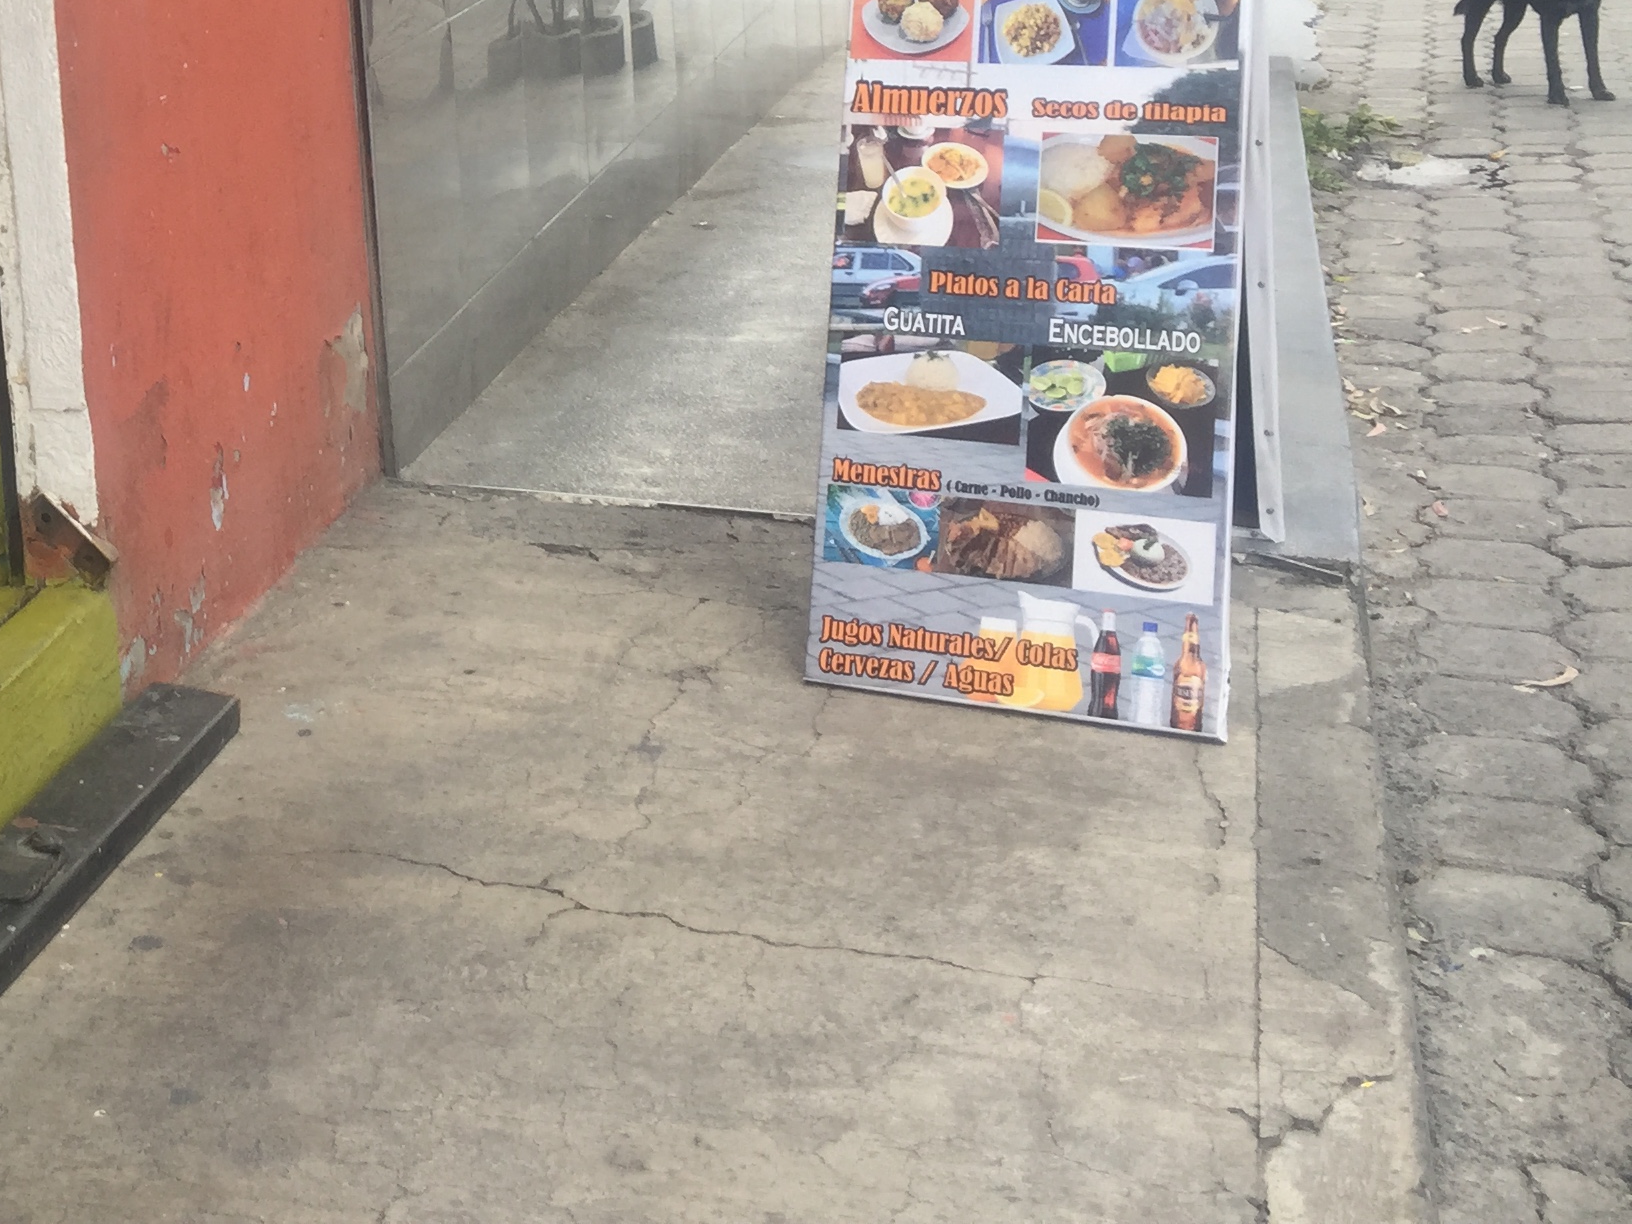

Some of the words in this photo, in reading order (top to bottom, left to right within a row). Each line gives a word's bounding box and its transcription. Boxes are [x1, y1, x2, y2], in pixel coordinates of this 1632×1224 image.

[850, 79, 1010, 119] Almuerzos
[1031, 98, 1099, 120] Secos
[1103, 100, 1137, 121] de
[1142, 100, 1228, 123] tilapia
[930, 270, 1000, 299] Platos
[1004, 280, 1020, 300] a
[1025, 275, 1050, 302] la
[1054, 278, 1118, 306] Carta
[831, 456, 943, 492] Menestras
[954, 479, 989, 497] Carne
[999, 484, 1033, 501] Pollo
[820, 614, 883, 648] Jugos
[1015, 639, 1080, 672] Colas
[818, 646, 915, 684] Cervezas
[942, 664, 1016, 698] Aguas
